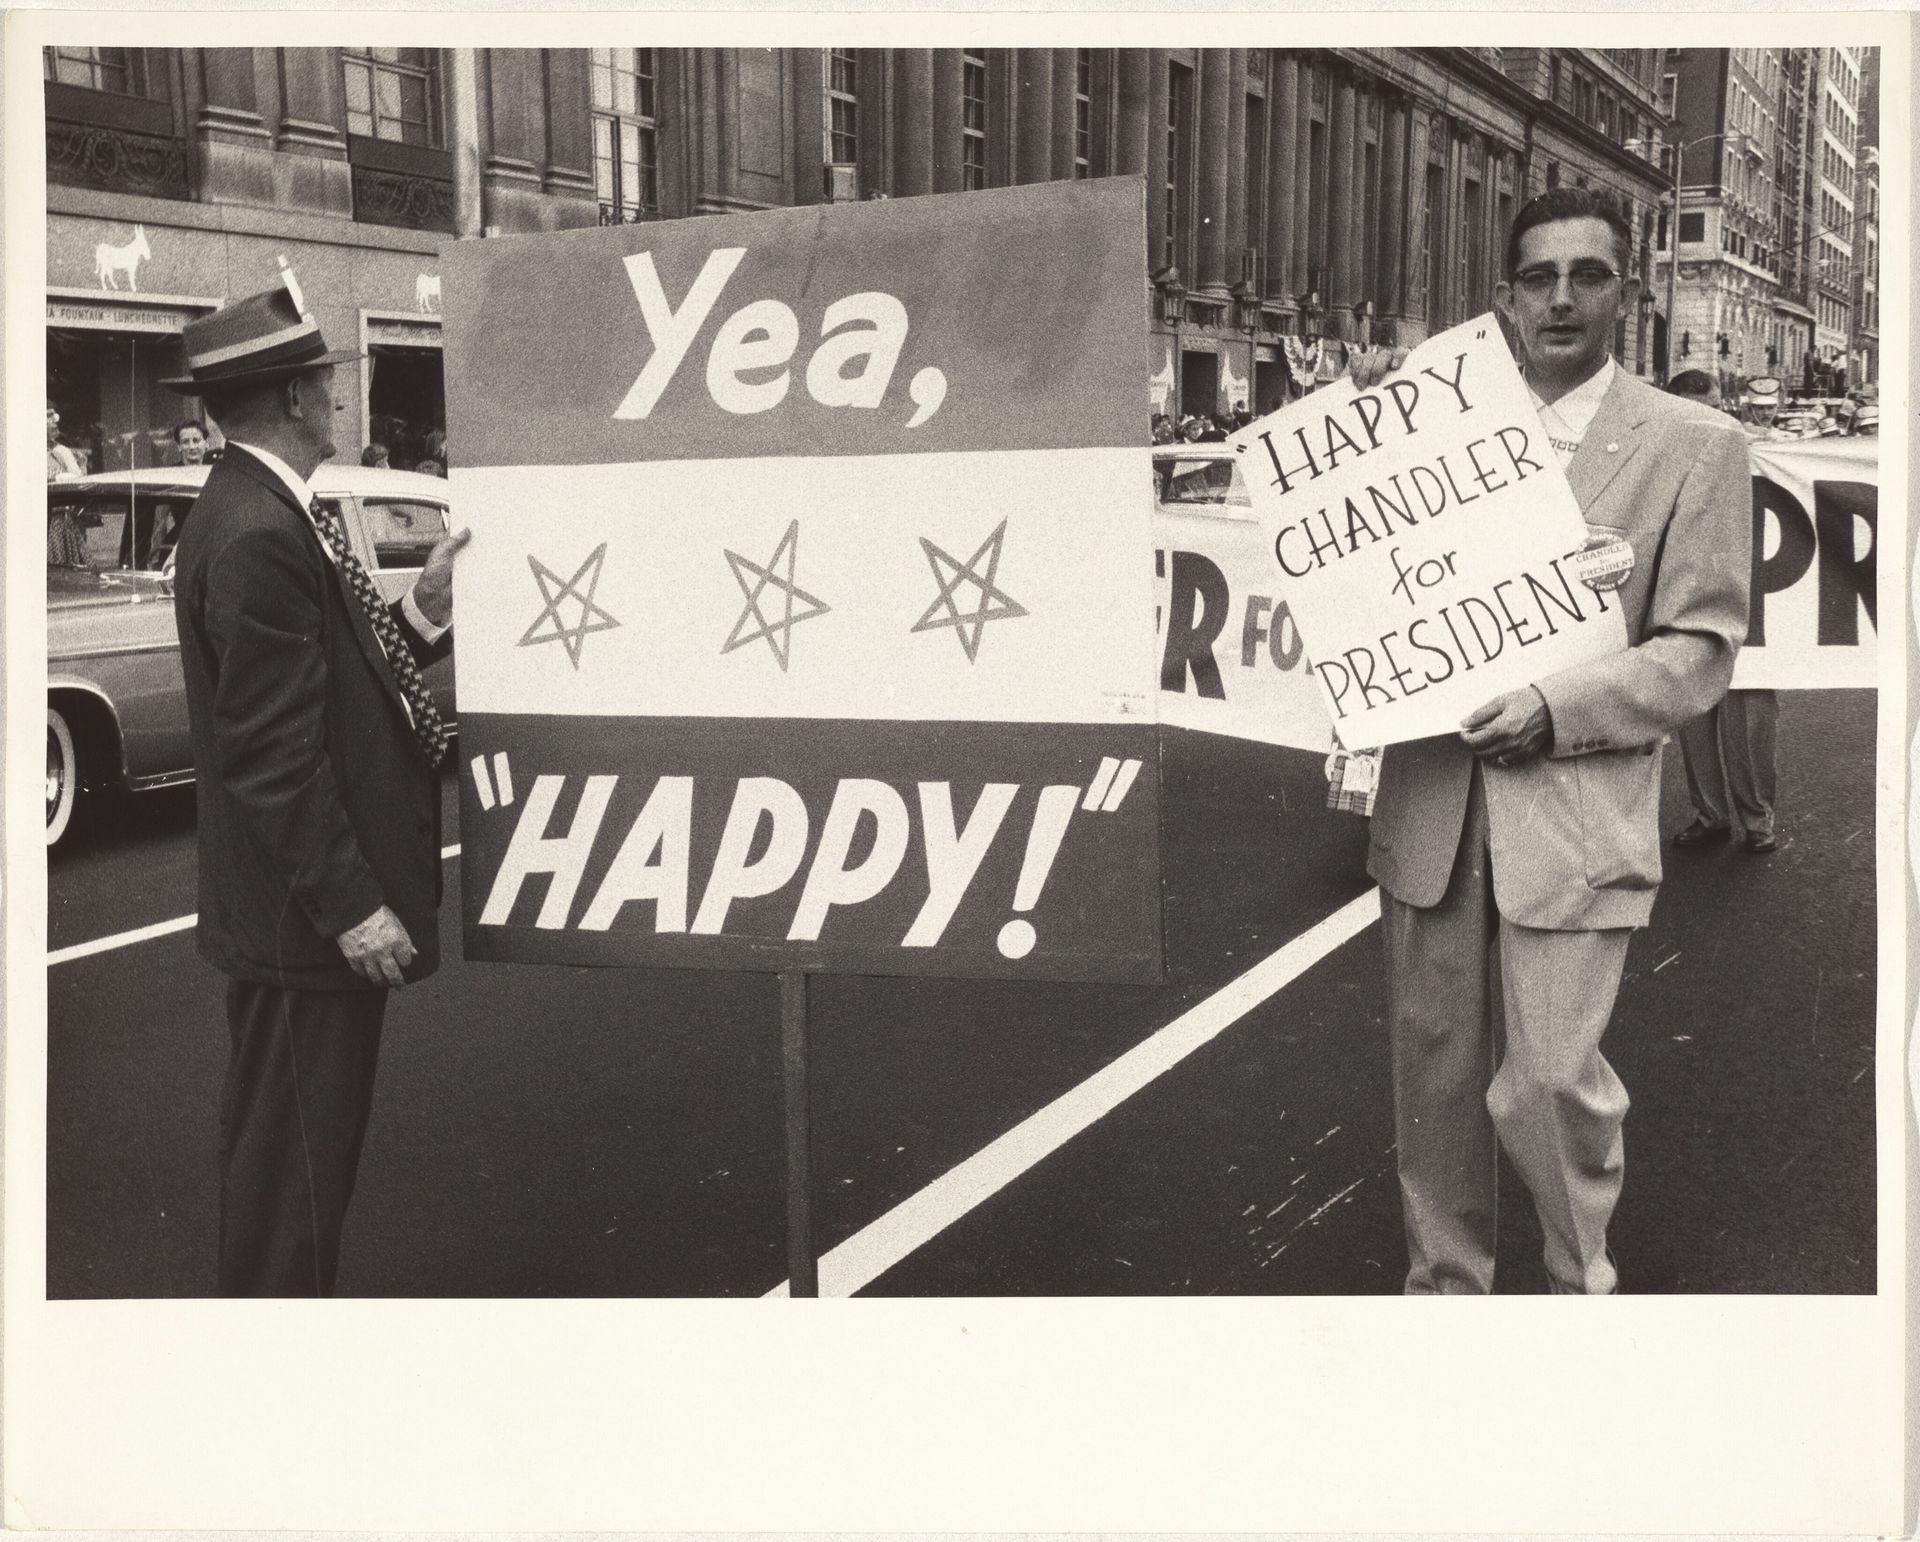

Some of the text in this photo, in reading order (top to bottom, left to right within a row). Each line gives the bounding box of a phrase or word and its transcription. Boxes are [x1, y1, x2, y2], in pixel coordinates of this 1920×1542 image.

[611, 246, 948, 429] Yea,
[1275, 426, 1544, 578] CHANDLER
[1391, 546, 1457, 605] for
[1241, 594, 1315, 676] FO
